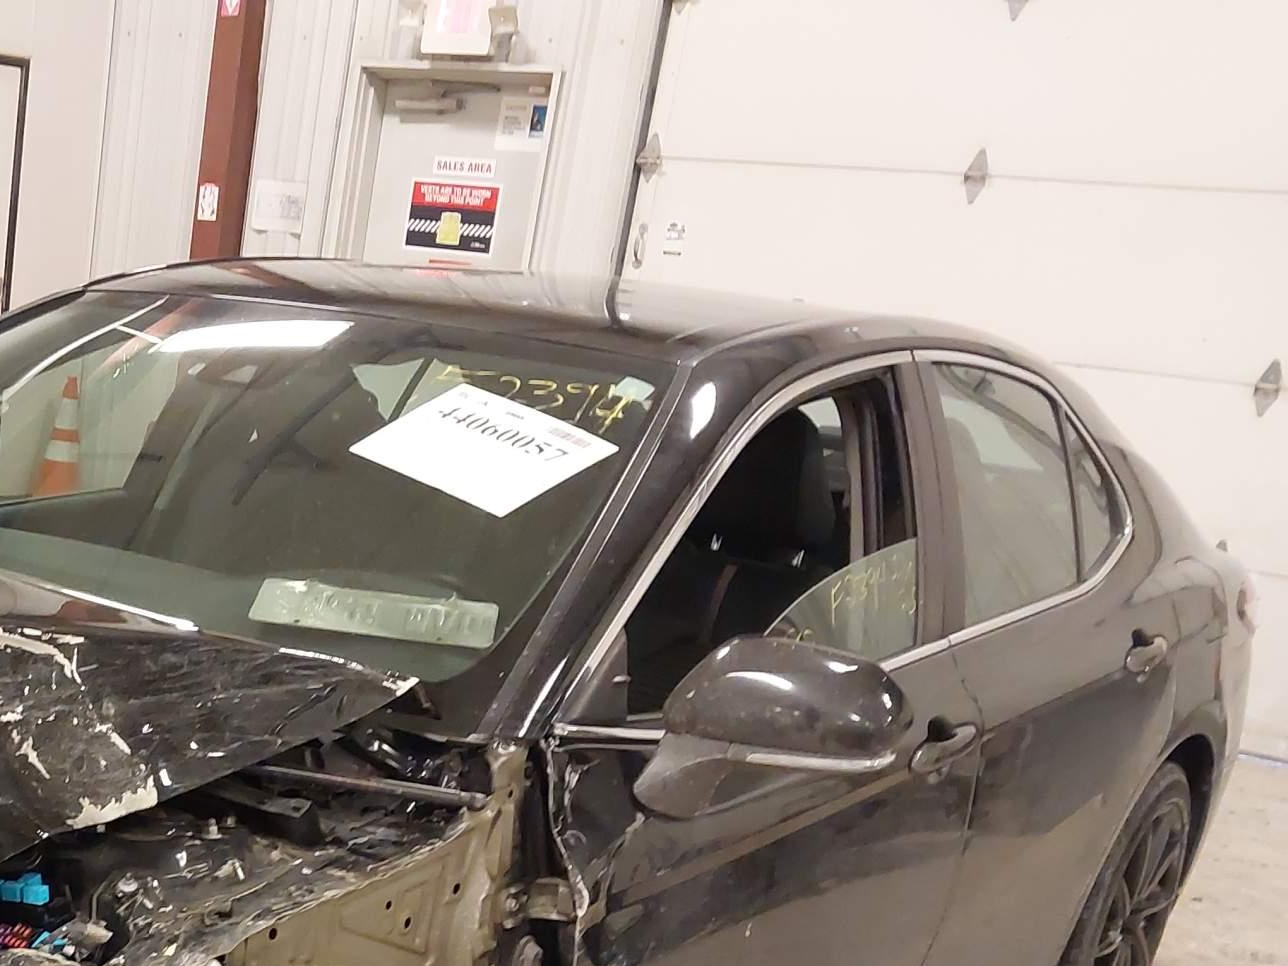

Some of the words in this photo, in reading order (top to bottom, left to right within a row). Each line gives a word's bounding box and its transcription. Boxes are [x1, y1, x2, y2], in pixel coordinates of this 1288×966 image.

[437, 160, 465, 171] SALES
[468, 163, 492, 173] AREA
[438, 407, 569, 461] 44060057
